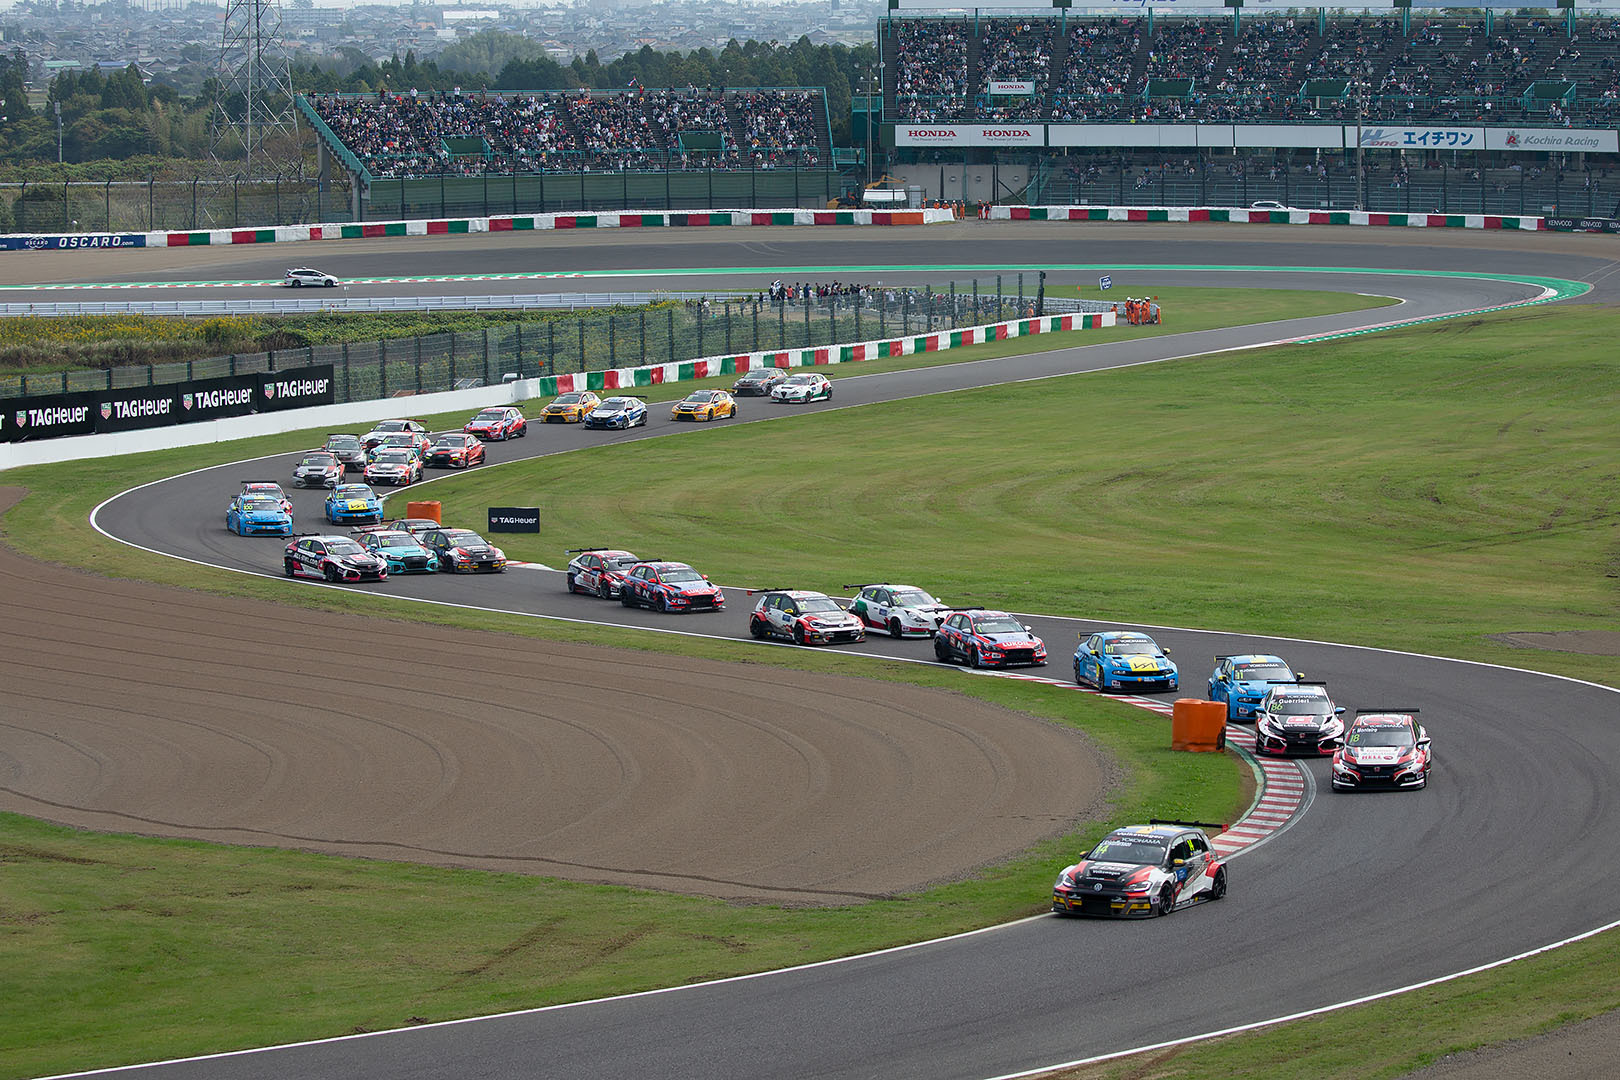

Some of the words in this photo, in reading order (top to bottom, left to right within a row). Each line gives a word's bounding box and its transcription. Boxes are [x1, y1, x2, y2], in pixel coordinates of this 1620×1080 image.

[1403, 131, 1474, 146] エイチワン
[1524, 135, 1561, 145] Kochira
[1564, 136, 1599, 148] Racing
[1271, 703, 1283, 711] 86
[1351, 733, 1360, 743] 18
[1116, 831, 1165, 840] Volkswagen
[1121, 837, 1161, 845] YOKOHAMA
[1095, 844, 1110, 855] 14
